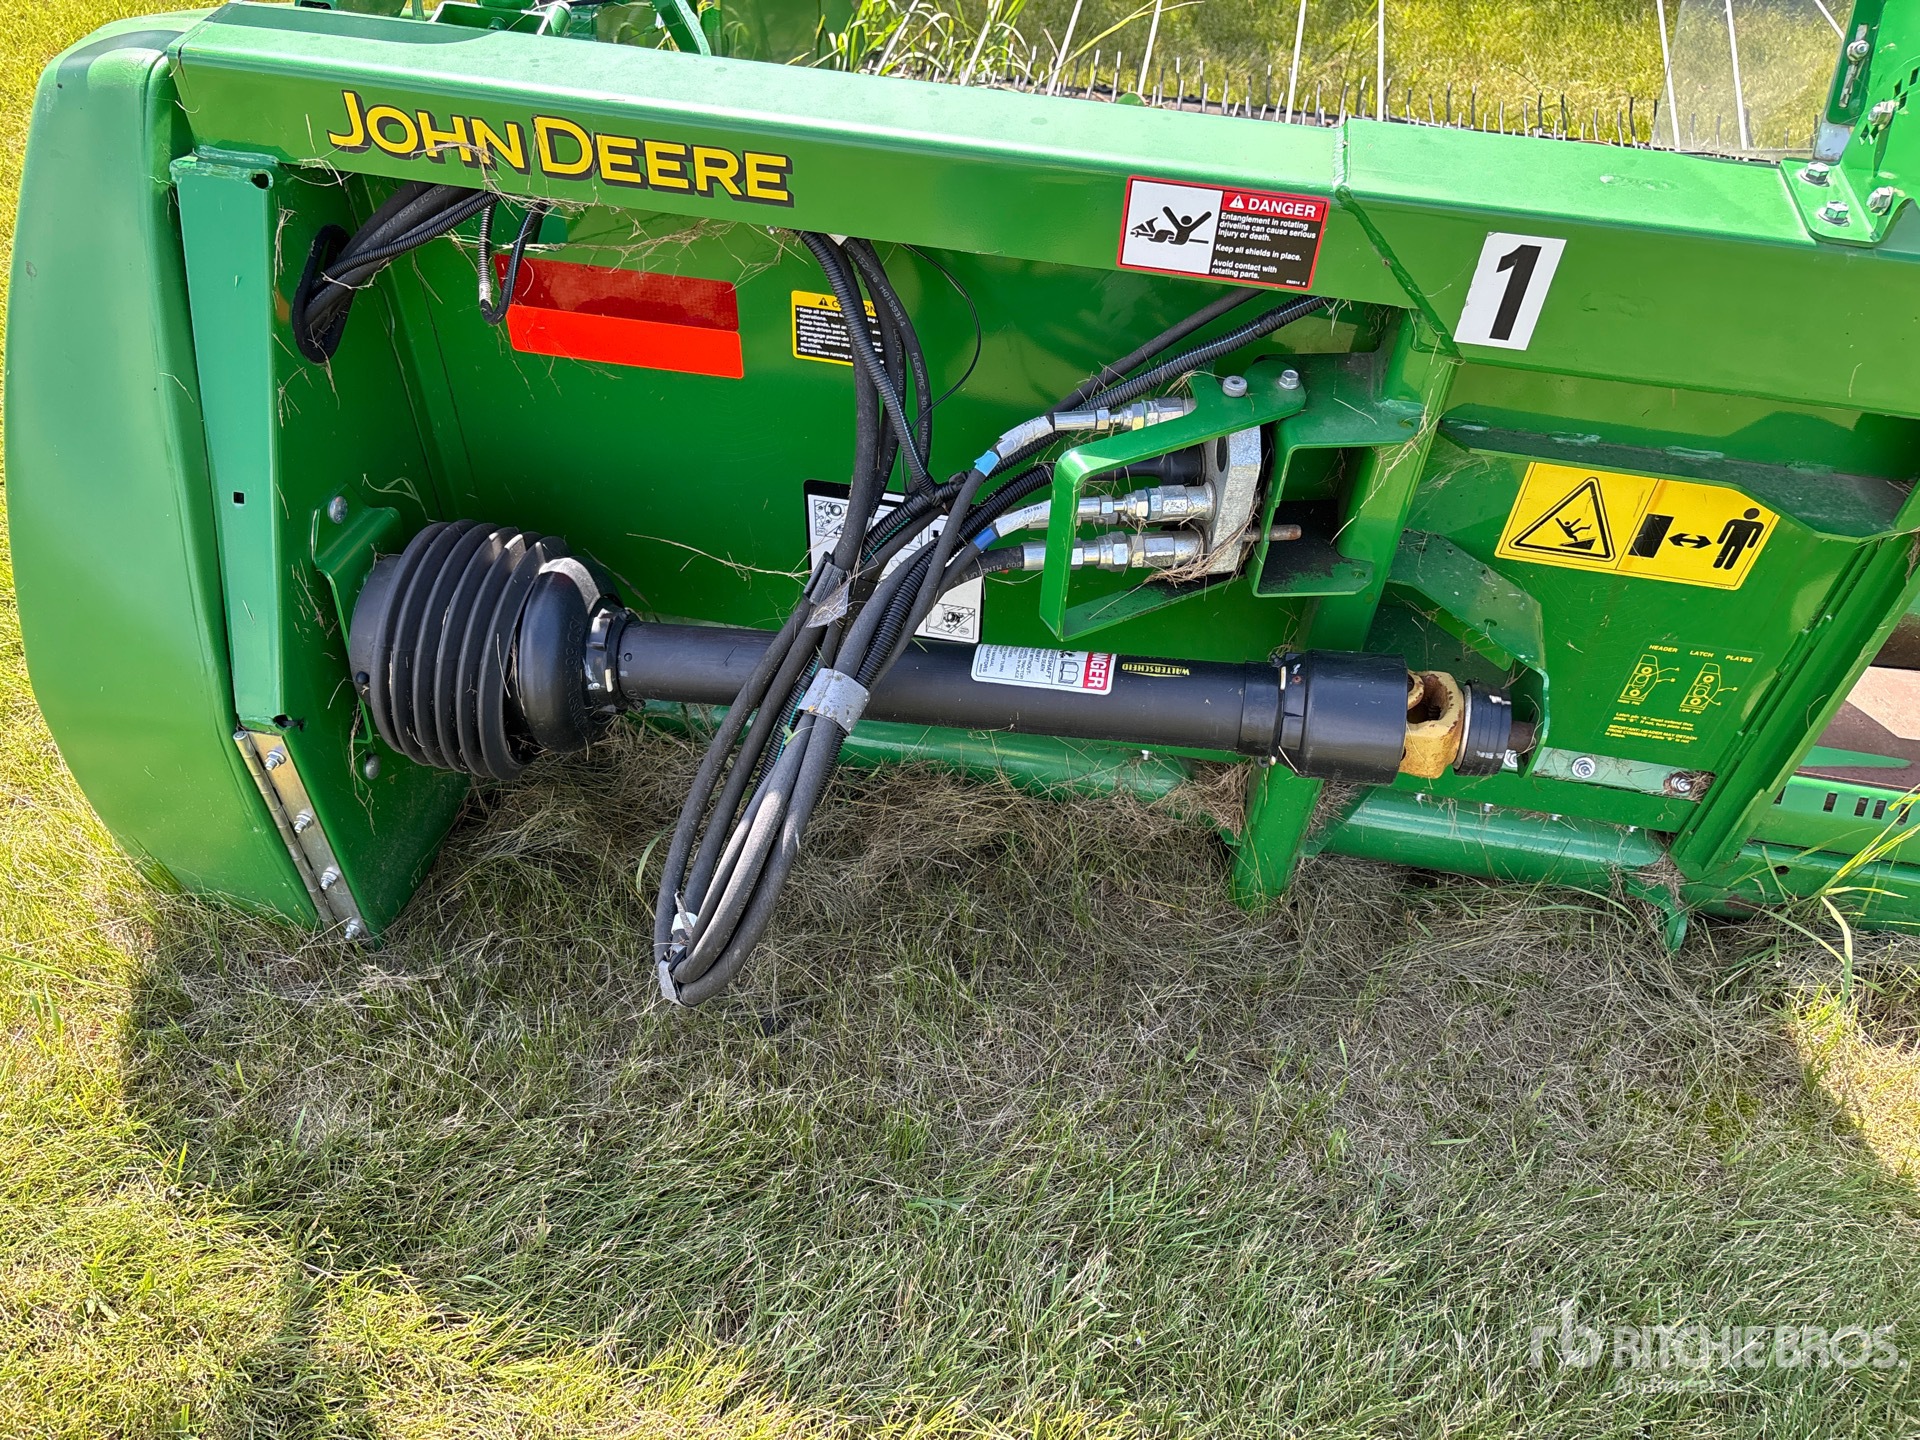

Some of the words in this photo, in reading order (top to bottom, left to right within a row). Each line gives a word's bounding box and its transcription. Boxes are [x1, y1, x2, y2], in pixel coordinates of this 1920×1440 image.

[328, 89, 529, 174] JOHN
[531, 114, 795, 208] DEERE
[1248, 198, 1316, 218] DANGER
[1219, 221, 1250, 231] driveline
[1251, 225, 1265, 233] can
[1266, 227, 1288, 236] cause
[1289, 230, 1316, 239] serious
[1221, 212, 1270, 224] Entanglement
[1272, 218, 1279, 226] in
[1280, 219, 1309, 231] rotating
[1218, 228, 1239, 239] injury
[1249, 232, 1271, 242] death.
[1215, 243, 1234, 254] Keep
[1235, 246, 1244, 254] all
[1245, 247, 1271, 257] shields
[1272, 250, 1279, 258] in
[1280, 253, 1302, 262] place.
[1211, 267, 1239, 278] rotating
[1239, 271, 1260, 280] parts.
[1213, 259, 1234, 268] Avoid
[1234, 262, 1261, 272] contact
[1262, 265, 1278, 274] with
[1489, 244, 1542, 341] 1
[1648, 644, 1679, 653] HEADER
[1689, 650, 1715, 658] LATCH
[1725, 654, 1754, 663] PLATES
[1121, 662, 1191, 677] WALTERSCHEID
